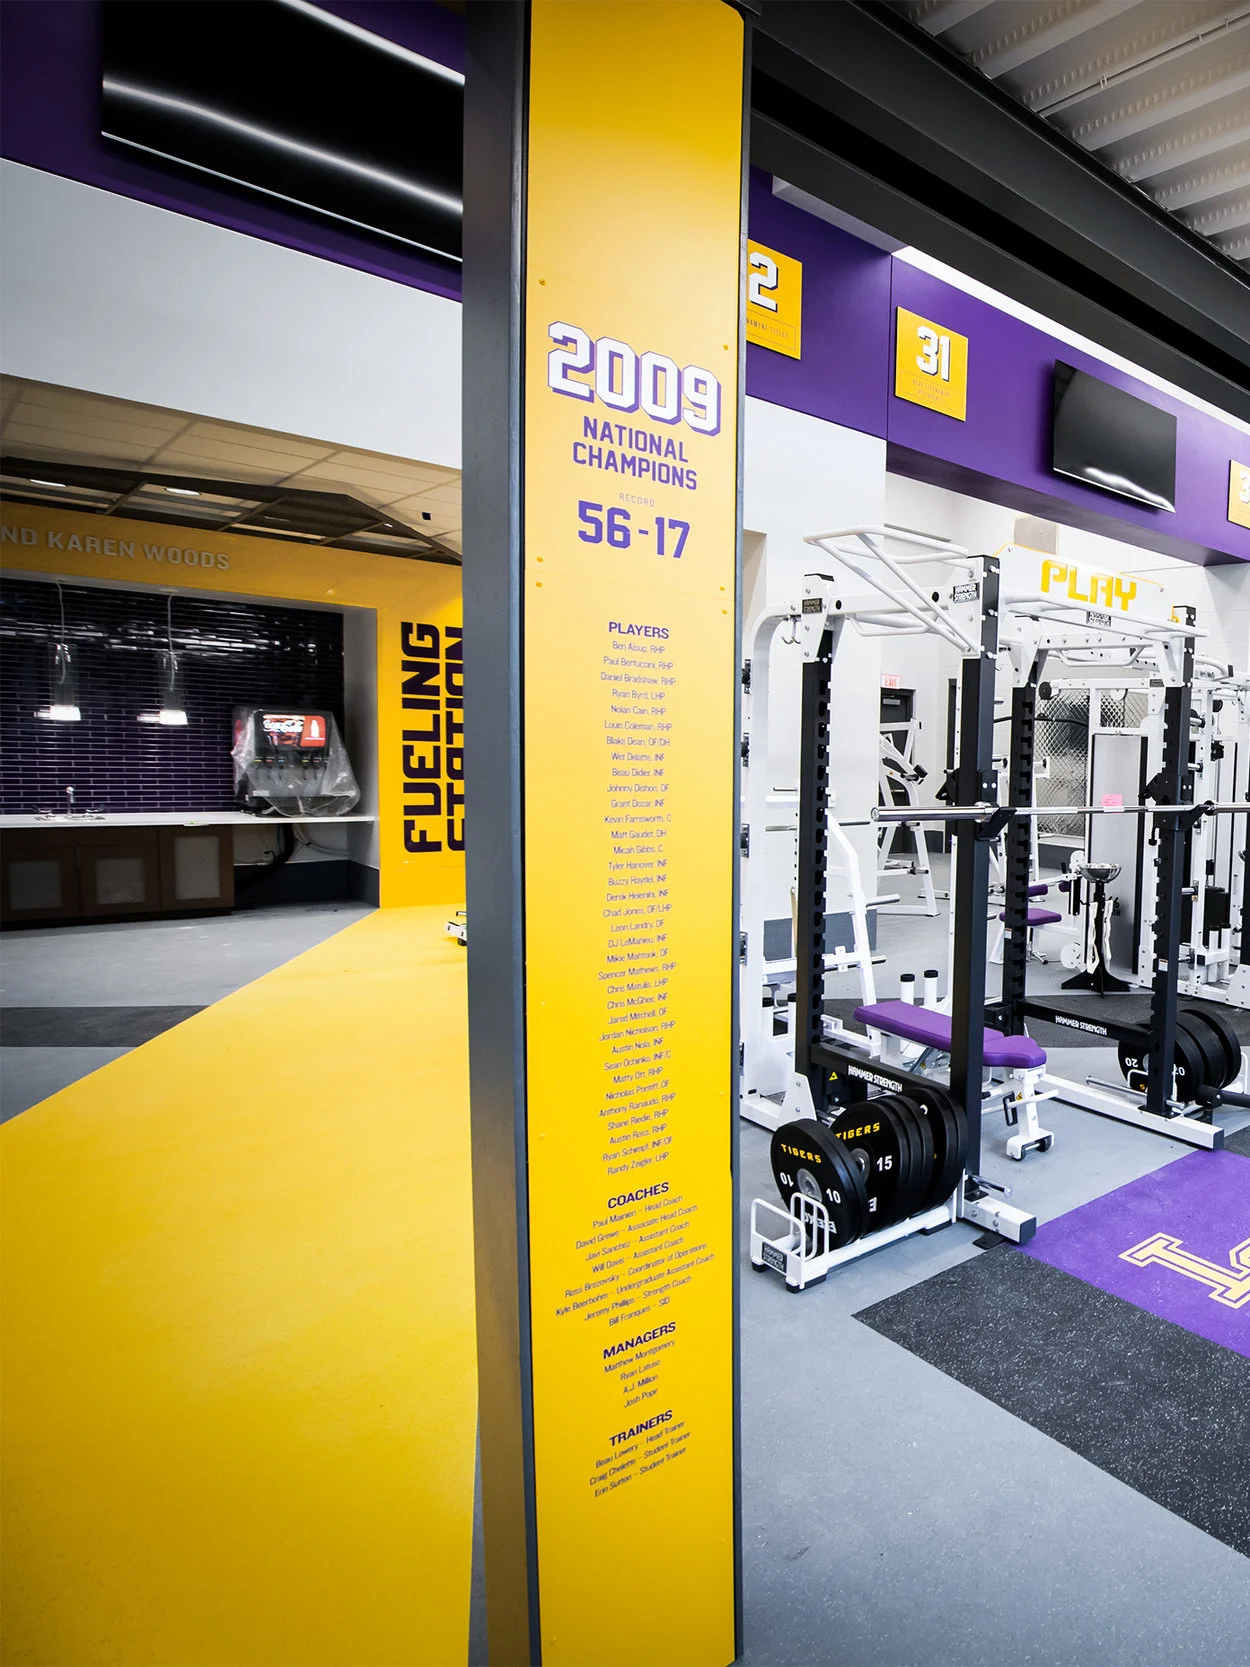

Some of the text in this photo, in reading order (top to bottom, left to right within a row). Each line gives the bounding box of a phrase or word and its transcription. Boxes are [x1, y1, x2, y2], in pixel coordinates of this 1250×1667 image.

[916, 326, 951, 382] 31
[548, 321, 721, 437] 2009
[583, 415, 688, 463] NATIONAL
[572, 441, 697, 490] CHAMPIONS
[619, 492, 655, 507] RECORD
[0, 525, 230, 570] ND KAREN WOODS
[1041, 559, 1137, 612] PLAY
[608, 621, 669, 639] PLAYERS
[612, 641, 626, 650] Ben
[650, 645, 665, 654] RHP
[601, 672, 676, 686] Daniel Bradshaw, RHP
[612, 689, 665, 700] Ryan Byrd, LHP
[401, 621, 442, 852] FUELING
[612, 768, 630, 776] Beau
[607, 784, 669, 794] Johnny Dishon, OF
[613, 846, 634, 854] Micah
[658, 844, 663, 852] C
[611, 923, 628, 932] Leon
[656, 919, 664, 927] OF
[607, 1000, 625, 1009] Chris
[657, 993, 668, 1001] INF
[608, 1015, 628, 1024] Jared
[659, 1007, 668, 1015] OF
[1055, 1015, 1107, 1036] HAMMER STRENGTH
[612, 1044, 633, 1054] Austin
[653, 1037, 664, 1046] INF
[848, 1065, 902, 1092] HAMMER STRENGTH
[610, 1134, 631, 1144] Austin
[652, 1123, 667, 1134] RHP
[836, 1122, 880, 1140] TIGERS
[781, 1143, 822, 1163] TIGERS
[877, 1155, 893, 1171] 15
[608, 1181, 669, 1208] COACHES
[826, 1188, 841, 1204] 10
[593, 1219, 608, 1229] Paul
[644, 1201, 662, 1212] Head
[663, 1195, 683, 1207] Coach
[603, 1321, 676, 1359] MANAGERS
[604, 1339, 676, 1373] Matthew Montgomery
[620, 1369, 638, 1381] Ryan
[623, 1373, 658, 1394] A.J. Million
[624, 1388, 658, 1408] Josh Pope
[609, 1409, 673, 1447] TRAINERS
